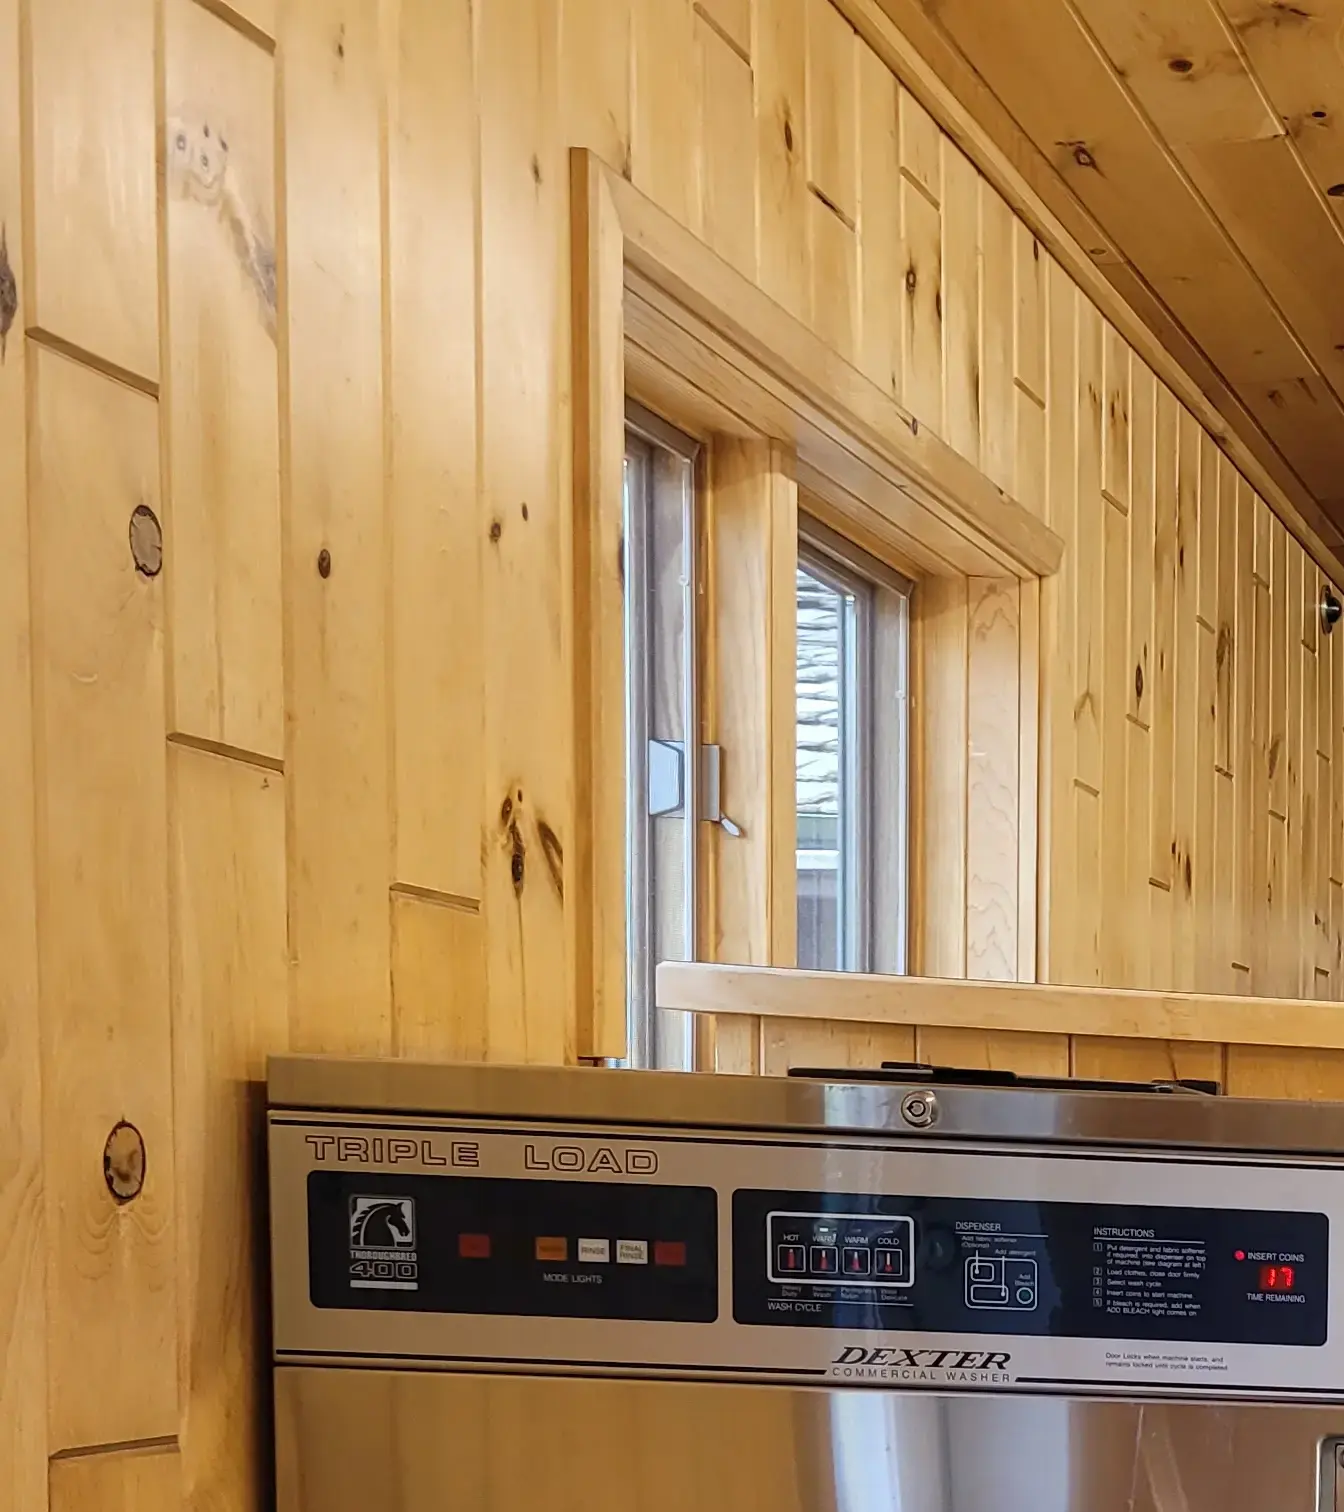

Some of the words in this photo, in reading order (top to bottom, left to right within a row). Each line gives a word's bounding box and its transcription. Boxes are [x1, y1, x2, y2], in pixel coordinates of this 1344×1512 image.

[305, 1135, 479, 1167] TRIPLE
[524, 1144, 658, 1174] LOAD
[956, 1222, 1001, 1231] DISPENSER
[1094, 1227, 1155, 1237] INSTRUCTIONS
[350, 1251, 417, 1261] THOROUGHBRED
[1248, 1252, 1277, 1260] INSERT
[1279, 1253, 1304, 1262] COINS
[350, 1261, 418, 1279] 400
[543, 1273, 568, 1283] MODE
[572, 1274, 602, 1284] LIGHTS
[1247, 1293, 1263, 1301] TIME
[1266, 1294, 1305, 1303] REMAINING
[768, 1302, 792, 1311] WASH
[795, 1304, 822, 1312] CYCLE
[832, 1347, 1011, 1369] DEXTER
[832, 1367, 936, 1380] COMMERCIAL
[946, 1371, 1010, 1382] WASHER
